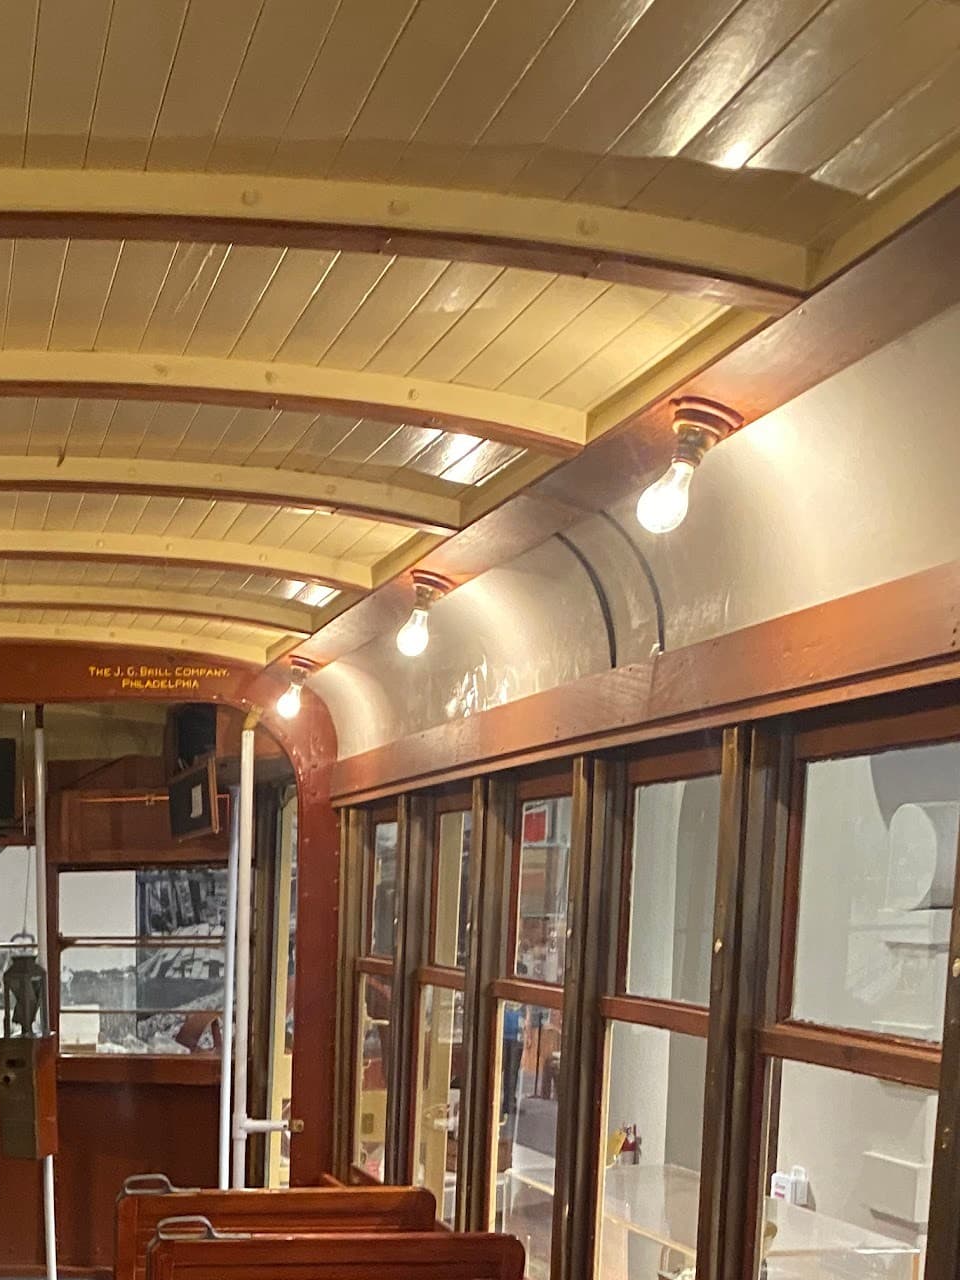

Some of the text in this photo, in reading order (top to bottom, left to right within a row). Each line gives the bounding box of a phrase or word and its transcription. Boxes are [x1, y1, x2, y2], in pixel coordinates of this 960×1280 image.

[88, 666, 111, 677] THE
[140, 666, 172, 677] BRILL
[121, 678, 200, 689] PHILADELPHIA
